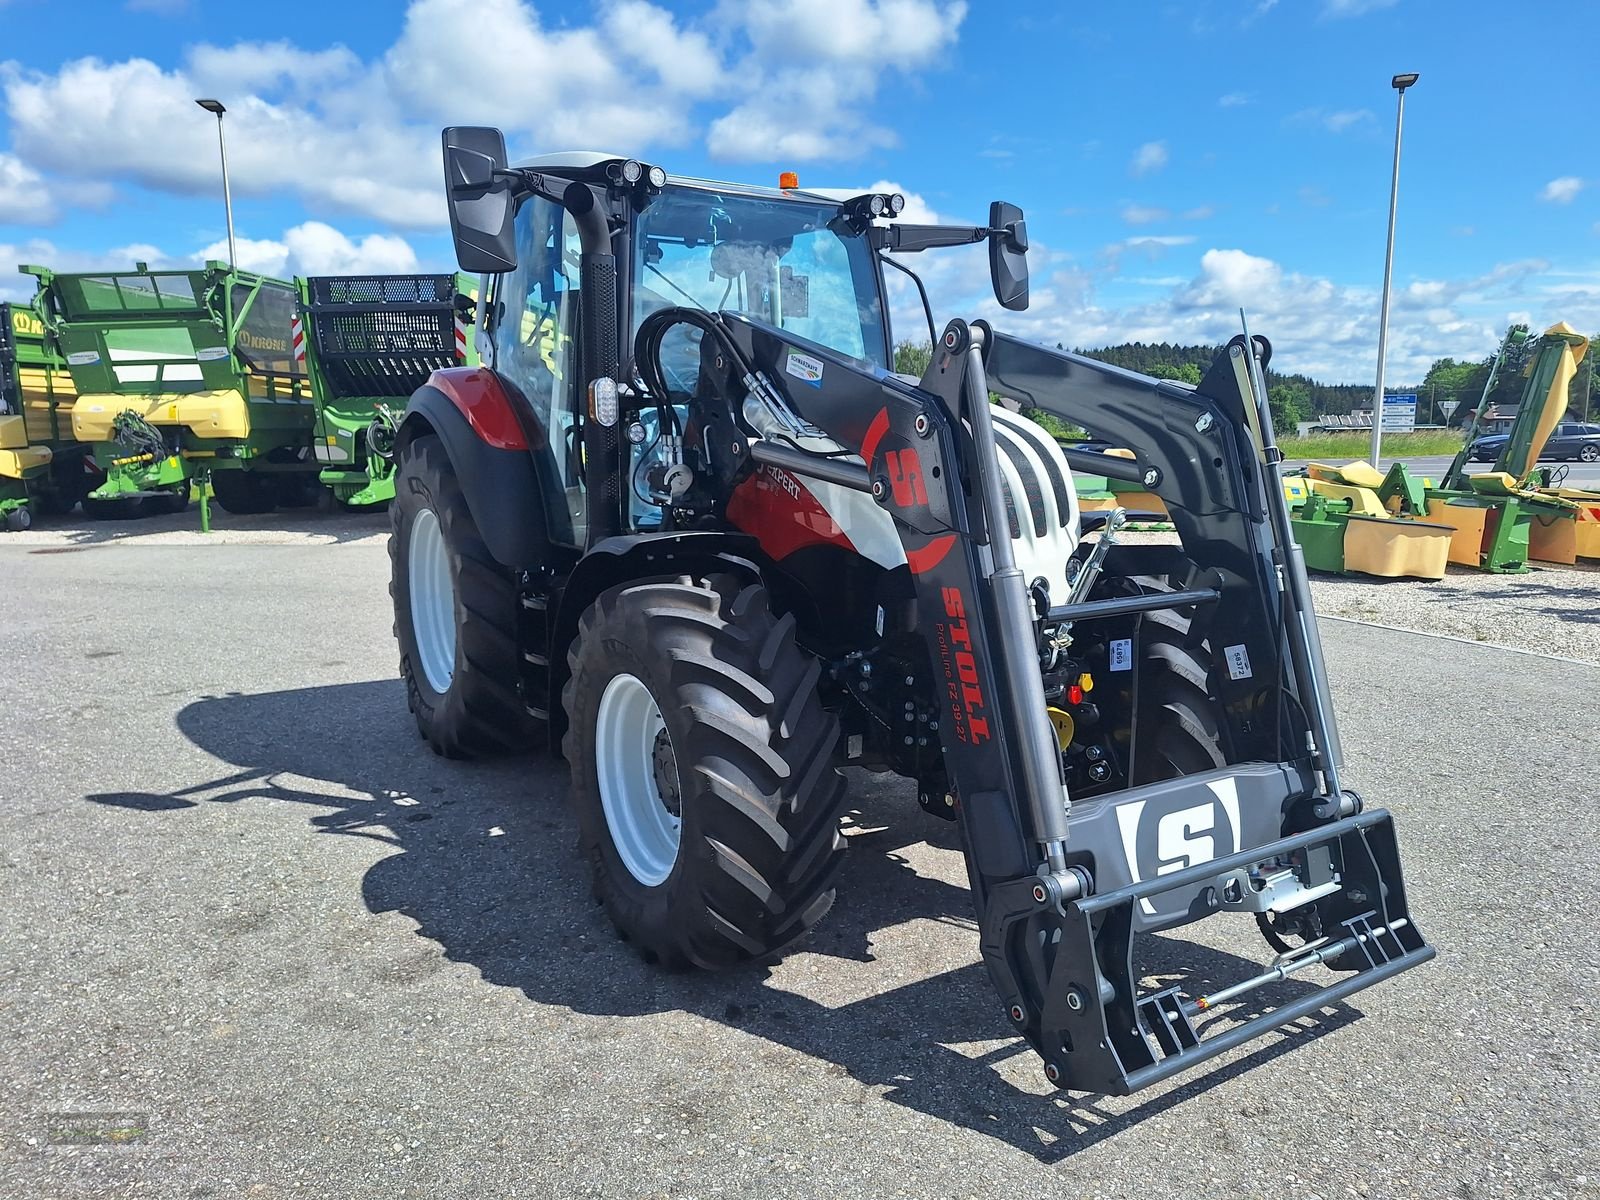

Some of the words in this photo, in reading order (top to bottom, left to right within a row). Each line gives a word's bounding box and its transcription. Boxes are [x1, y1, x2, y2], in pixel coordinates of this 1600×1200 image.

[251, 335, 286, 351] KRONE
[767, 465, 801, 500] EXPERT
[936, 623, 952, 679] ProfiLine
[941, 586, 991, 745] STOLL
[948, 682, 958, 700] FZ
[952, 703, 967, 742] 39-27
